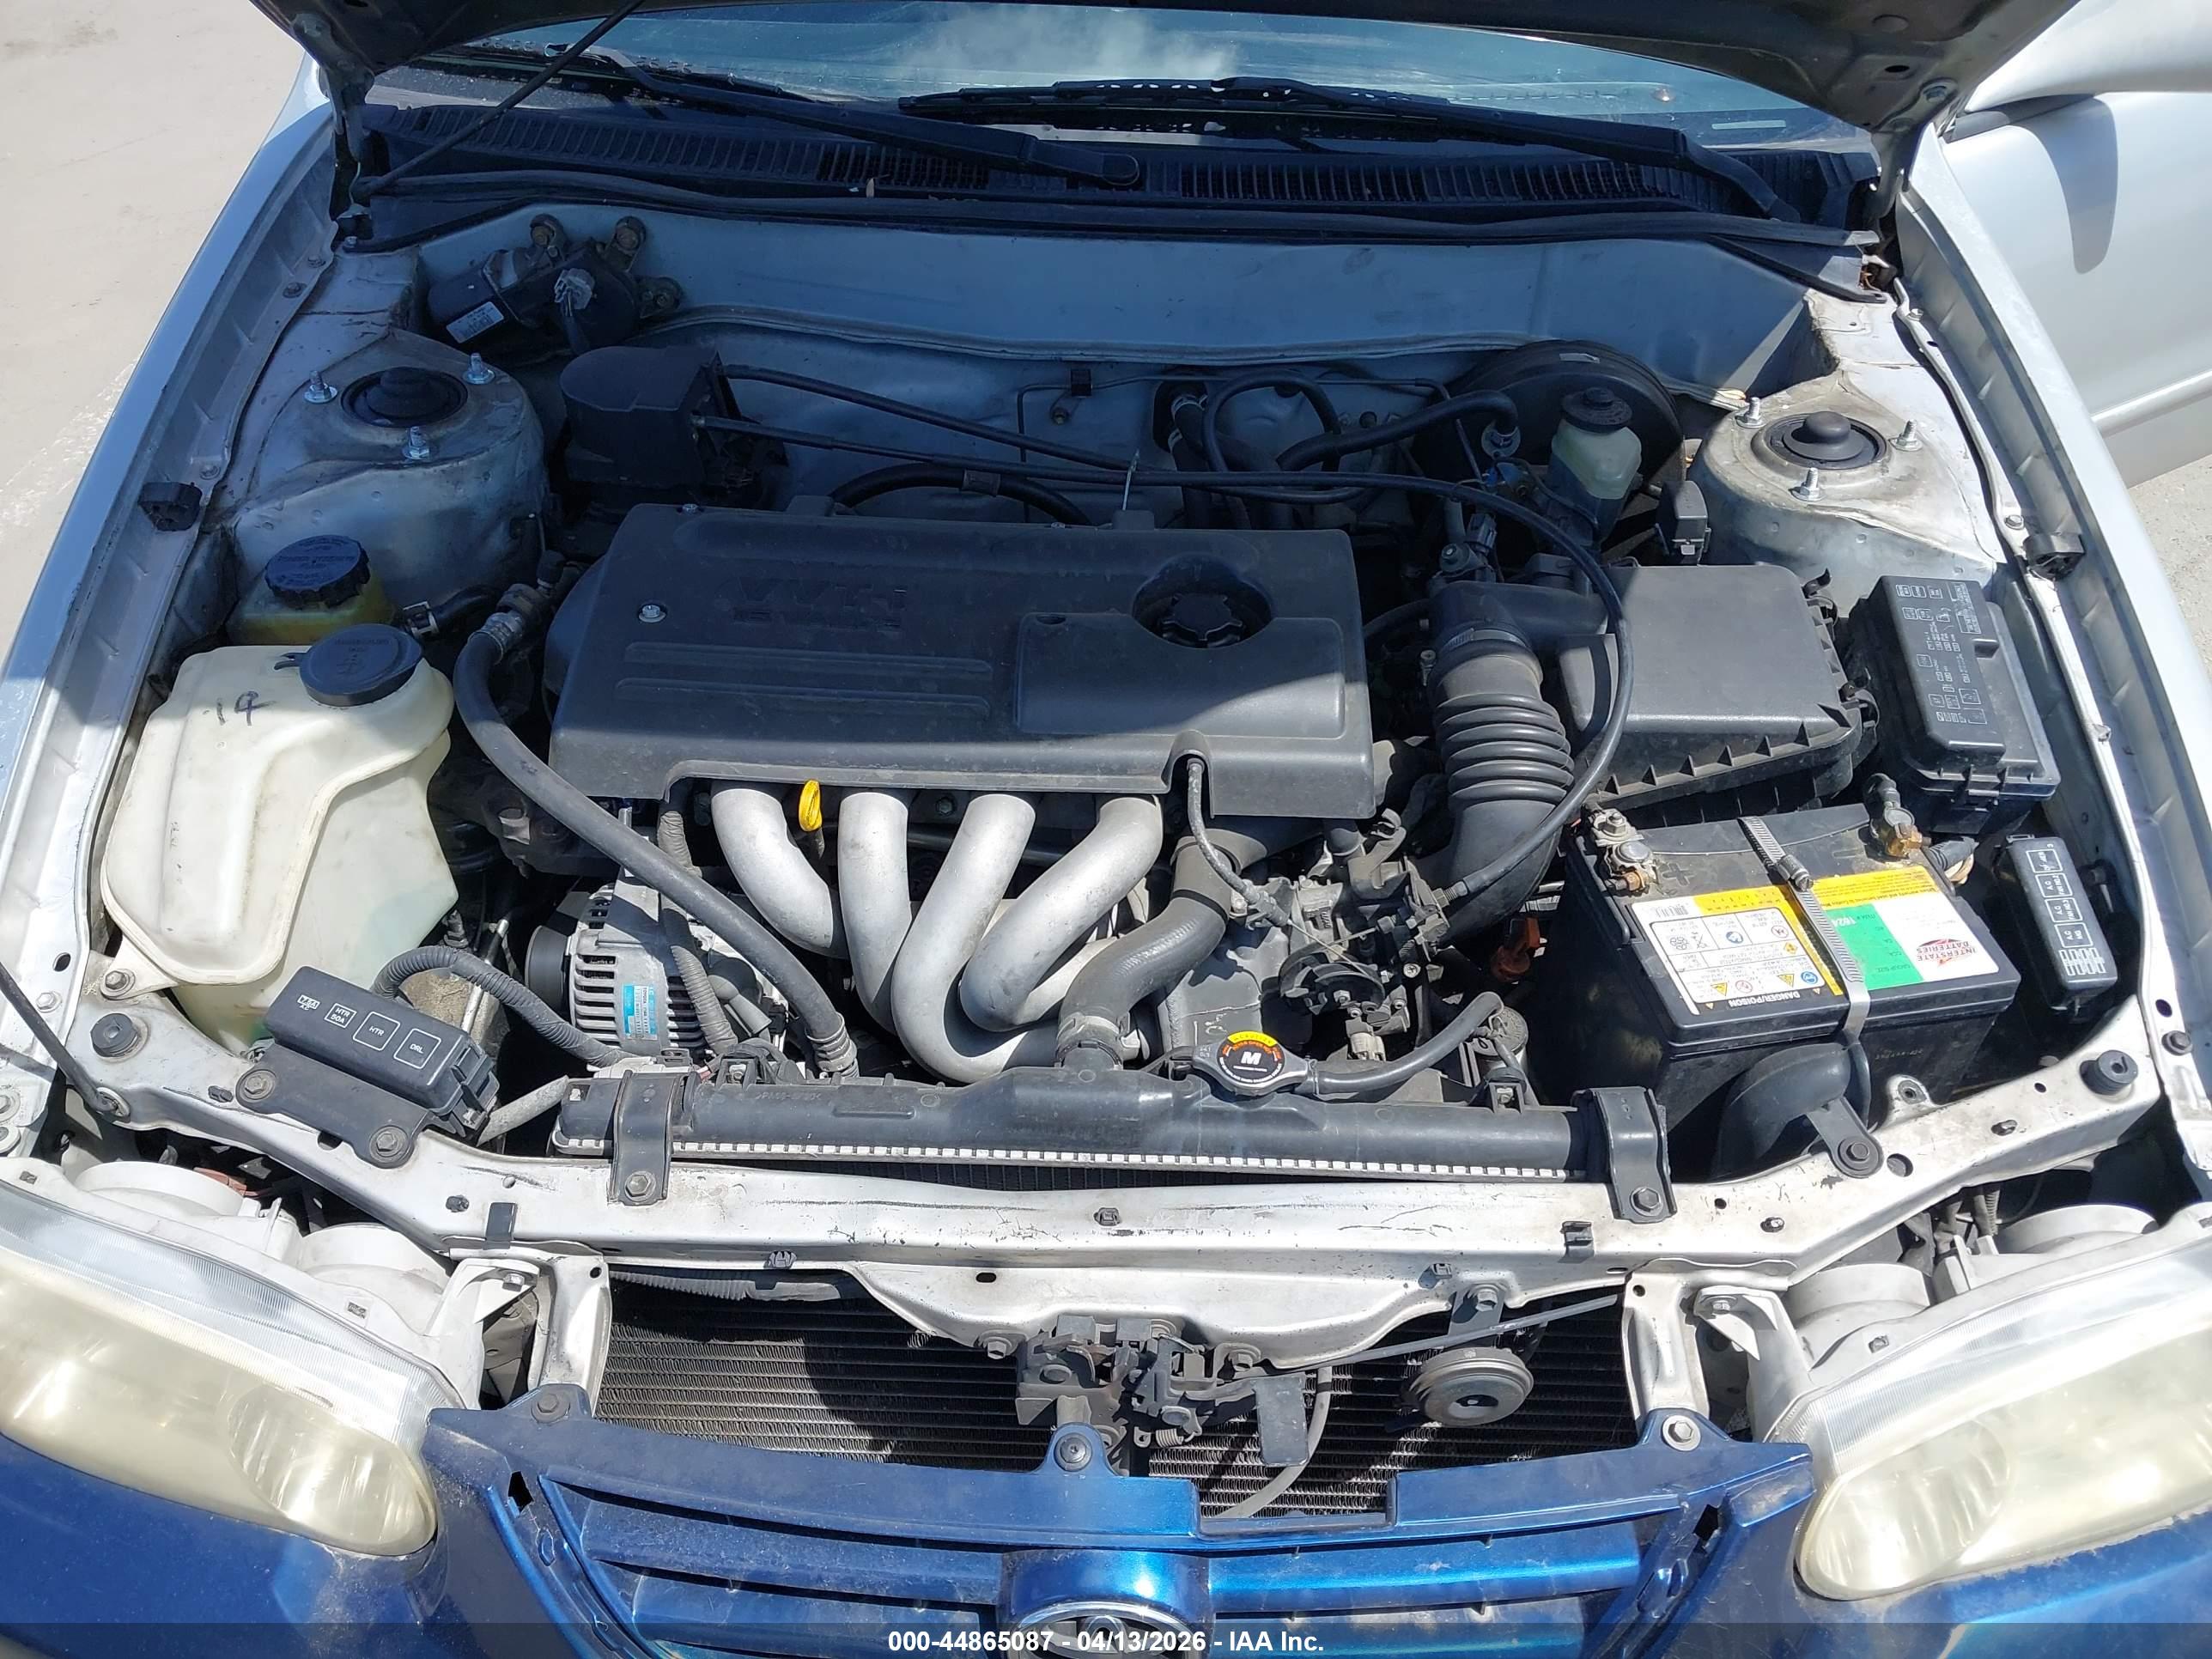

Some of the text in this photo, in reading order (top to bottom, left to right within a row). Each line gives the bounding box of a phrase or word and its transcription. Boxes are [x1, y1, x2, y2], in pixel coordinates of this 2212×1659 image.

[1917, 947, 1976, 962] INTERSTATE
[1728, 990, 1801, 1008] DANGER/POISON
[335, 1007, 350, 1018] HTR
[330, 1013, 345, 1024] 50A
[368, 1025, 385, 1036] HTR
[410, 1043, 424, 1054] DRL
